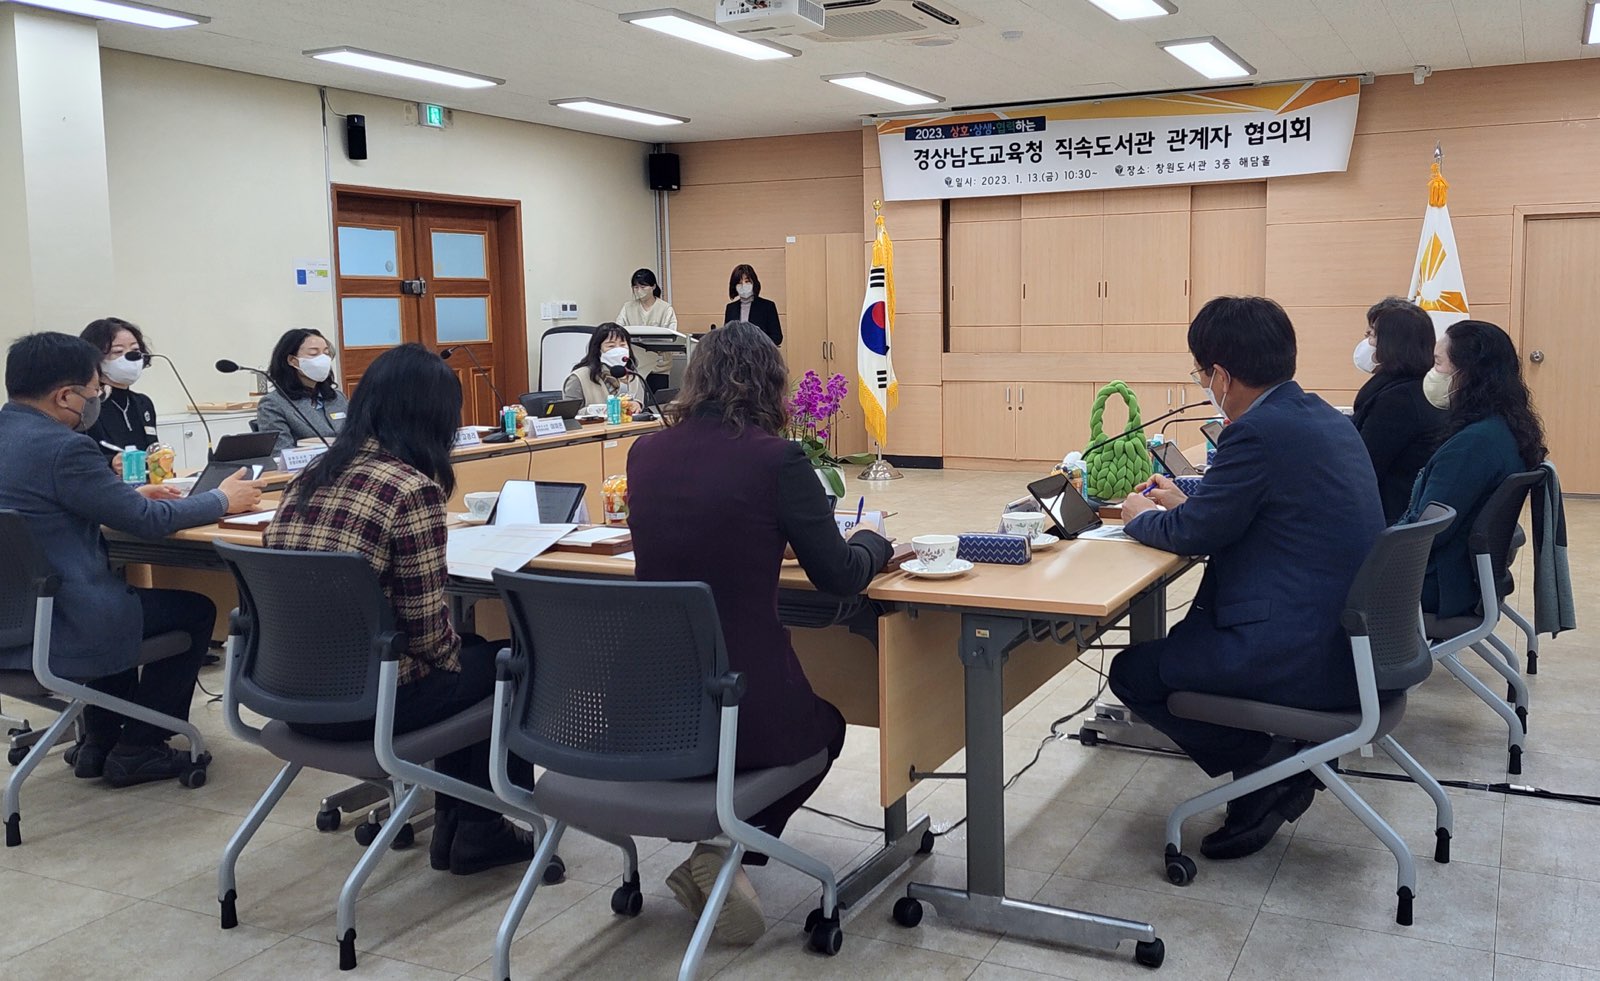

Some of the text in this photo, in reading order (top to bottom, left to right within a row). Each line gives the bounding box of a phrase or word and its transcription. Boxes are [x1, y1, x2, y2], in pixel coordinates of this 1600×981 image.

[914, 117, 1311, 170] 경상남도교육청 직속도서관 관계자 협의회
[915, 127, 945, 140] 2023.
[1126, 155, 1271, 176] 장소: 창원도서관 3층 해담홀
[955, 177, 976, 188] 일시:
[981, 175, 1010, 186] 2023.
[1015, 174, 1023, 184] 1.
[1064, 168, 1098, 180] 10:30~
